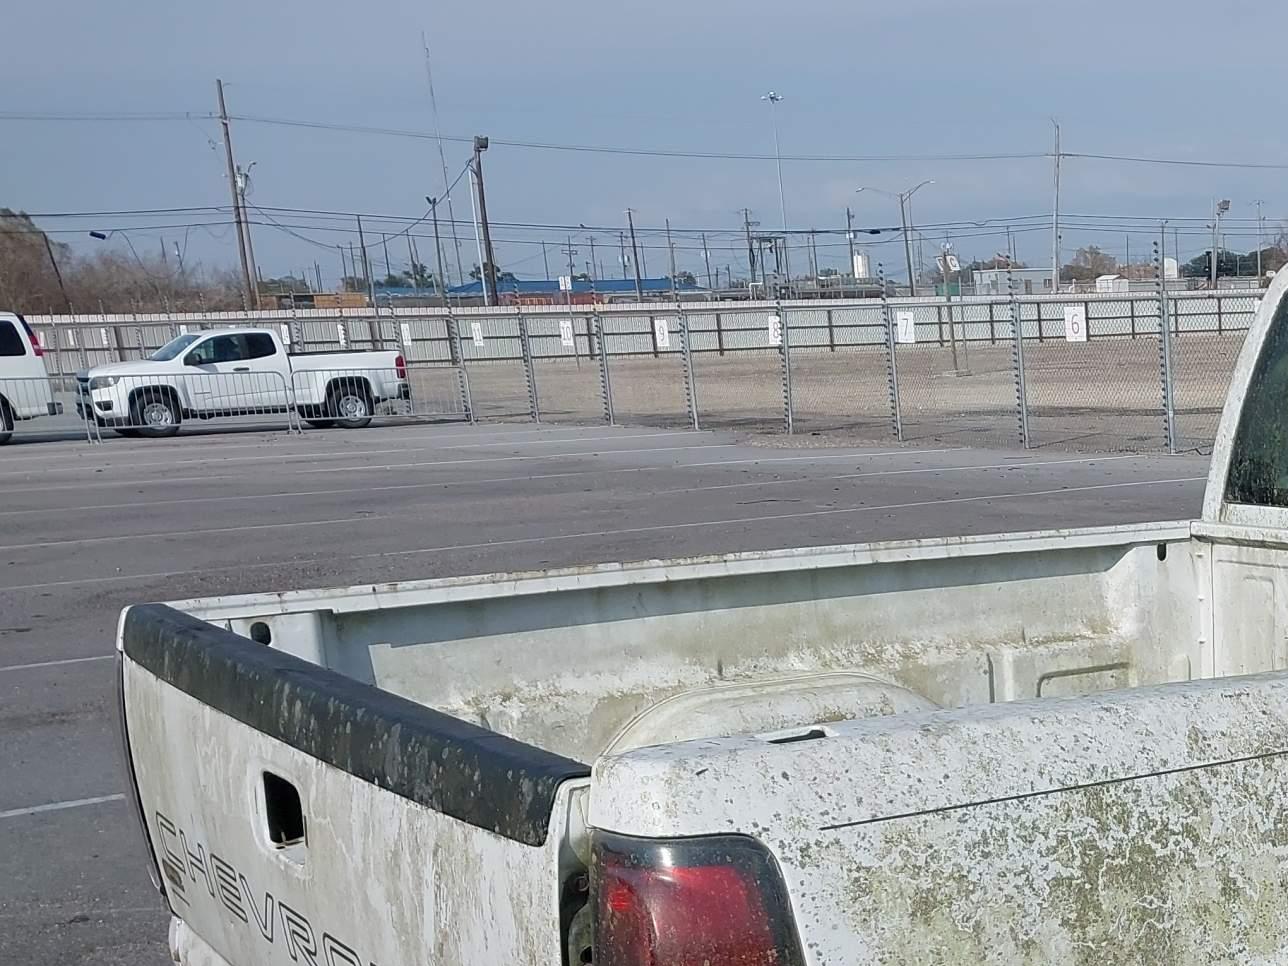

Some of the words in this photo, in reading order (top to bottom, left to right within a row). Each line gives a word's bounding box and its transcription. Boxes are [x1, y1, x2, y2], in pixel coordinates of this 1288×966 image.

[561, 325, 572, 341] 10
[902, 318, 909, 337] 7
[1070, 313, 1080, 335] 6
[658, 325, 665, 342] 9
